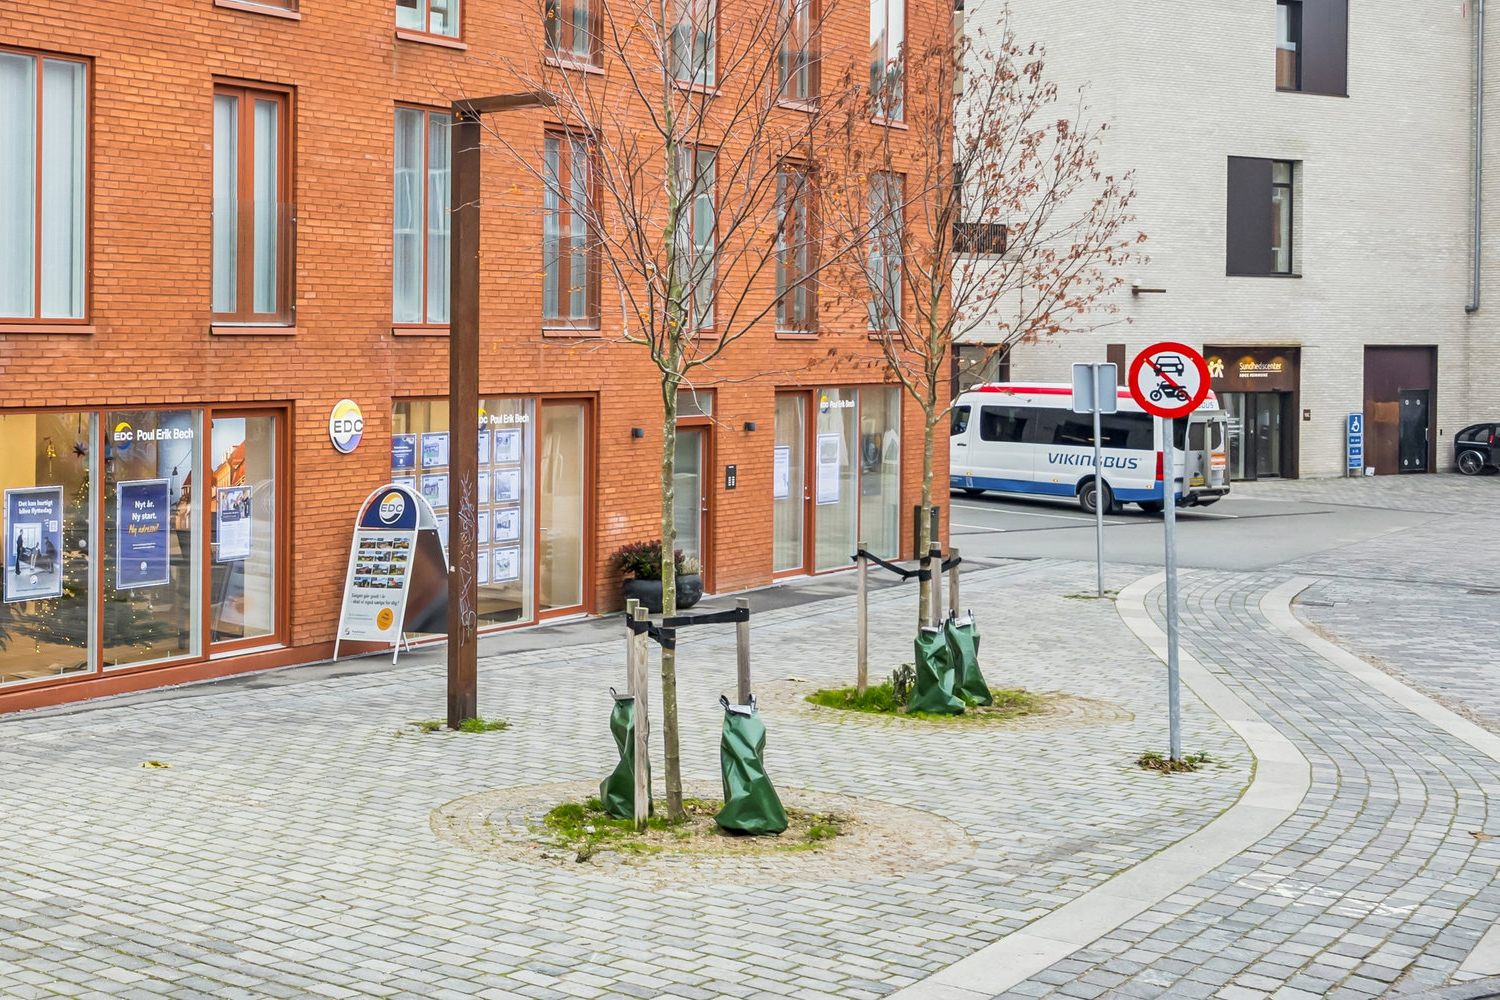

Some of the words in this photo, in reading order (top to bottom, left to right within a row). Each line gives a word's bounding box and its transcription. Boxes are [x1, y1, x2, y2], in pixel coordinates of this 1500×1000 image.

[1239, 362, 1282, 370] Sundhedscenter
[490, 414, 503, 424] Poul
[504, 414, 514, 424] Erik
[515, 413, 529, 423] Bech
[334, 420, 363, 433] EDC
[114, 432, 133, 441] EDC
[136, 429, 155, 441] Poul
[156, 428, 172, 440] Erik
[173, 428, 194, 439] Bech
[36, 499, 53, 507] hurtigt
[134, 500, 146, 510] Nyt
[380, 503, 403, 512] EDC
[31, 507, 53, 515] flyttedag
[131, 513, 141, 522] Ny
[141, 512, 157, 520] start.
